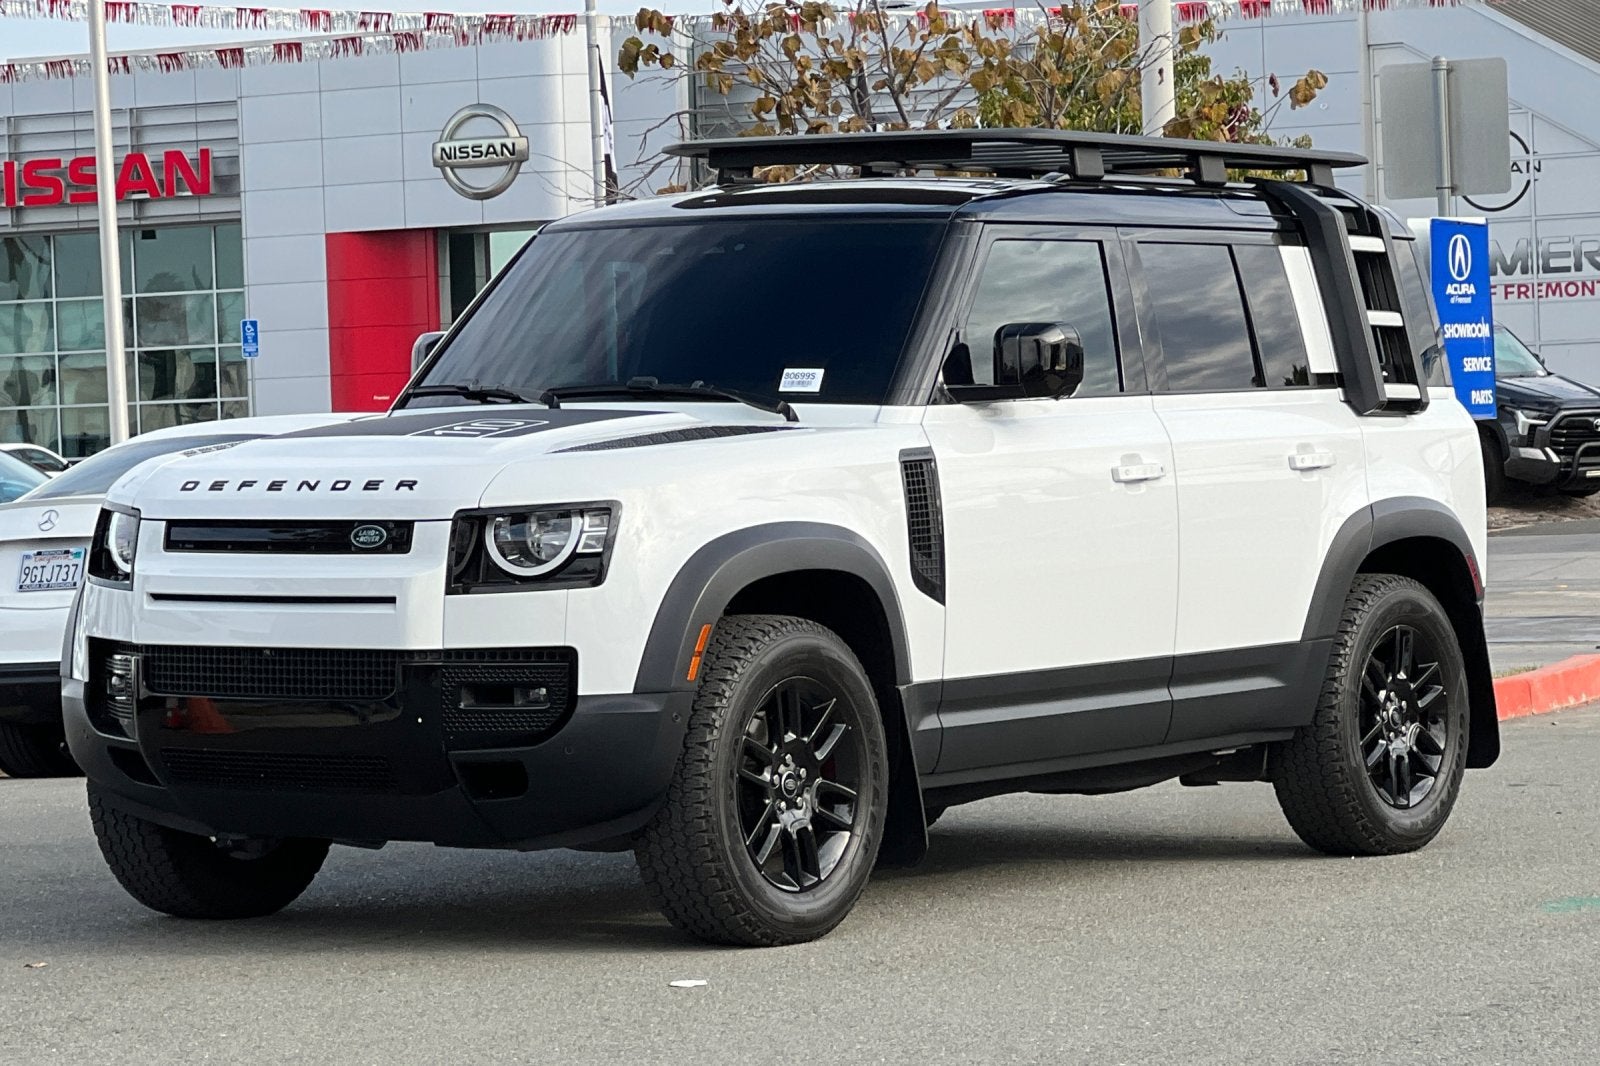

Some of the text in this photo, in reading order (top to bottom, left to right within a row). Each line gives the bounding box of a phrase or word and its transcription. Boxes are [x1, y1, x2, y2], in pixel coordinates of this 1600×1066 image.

[440, 142, 516, 161] NISSAN
[1445, 283, 1476, 295] ACURA
[1444, 322, 1490, 338] SHOWROOM
[1463, 356, 1492, 372] SERVICE
[1471, 389, 1493, 405] PARTS
[180, 479, 418, 492] DEFENDER
[23, 564, 79, 583] 9GIJ737
